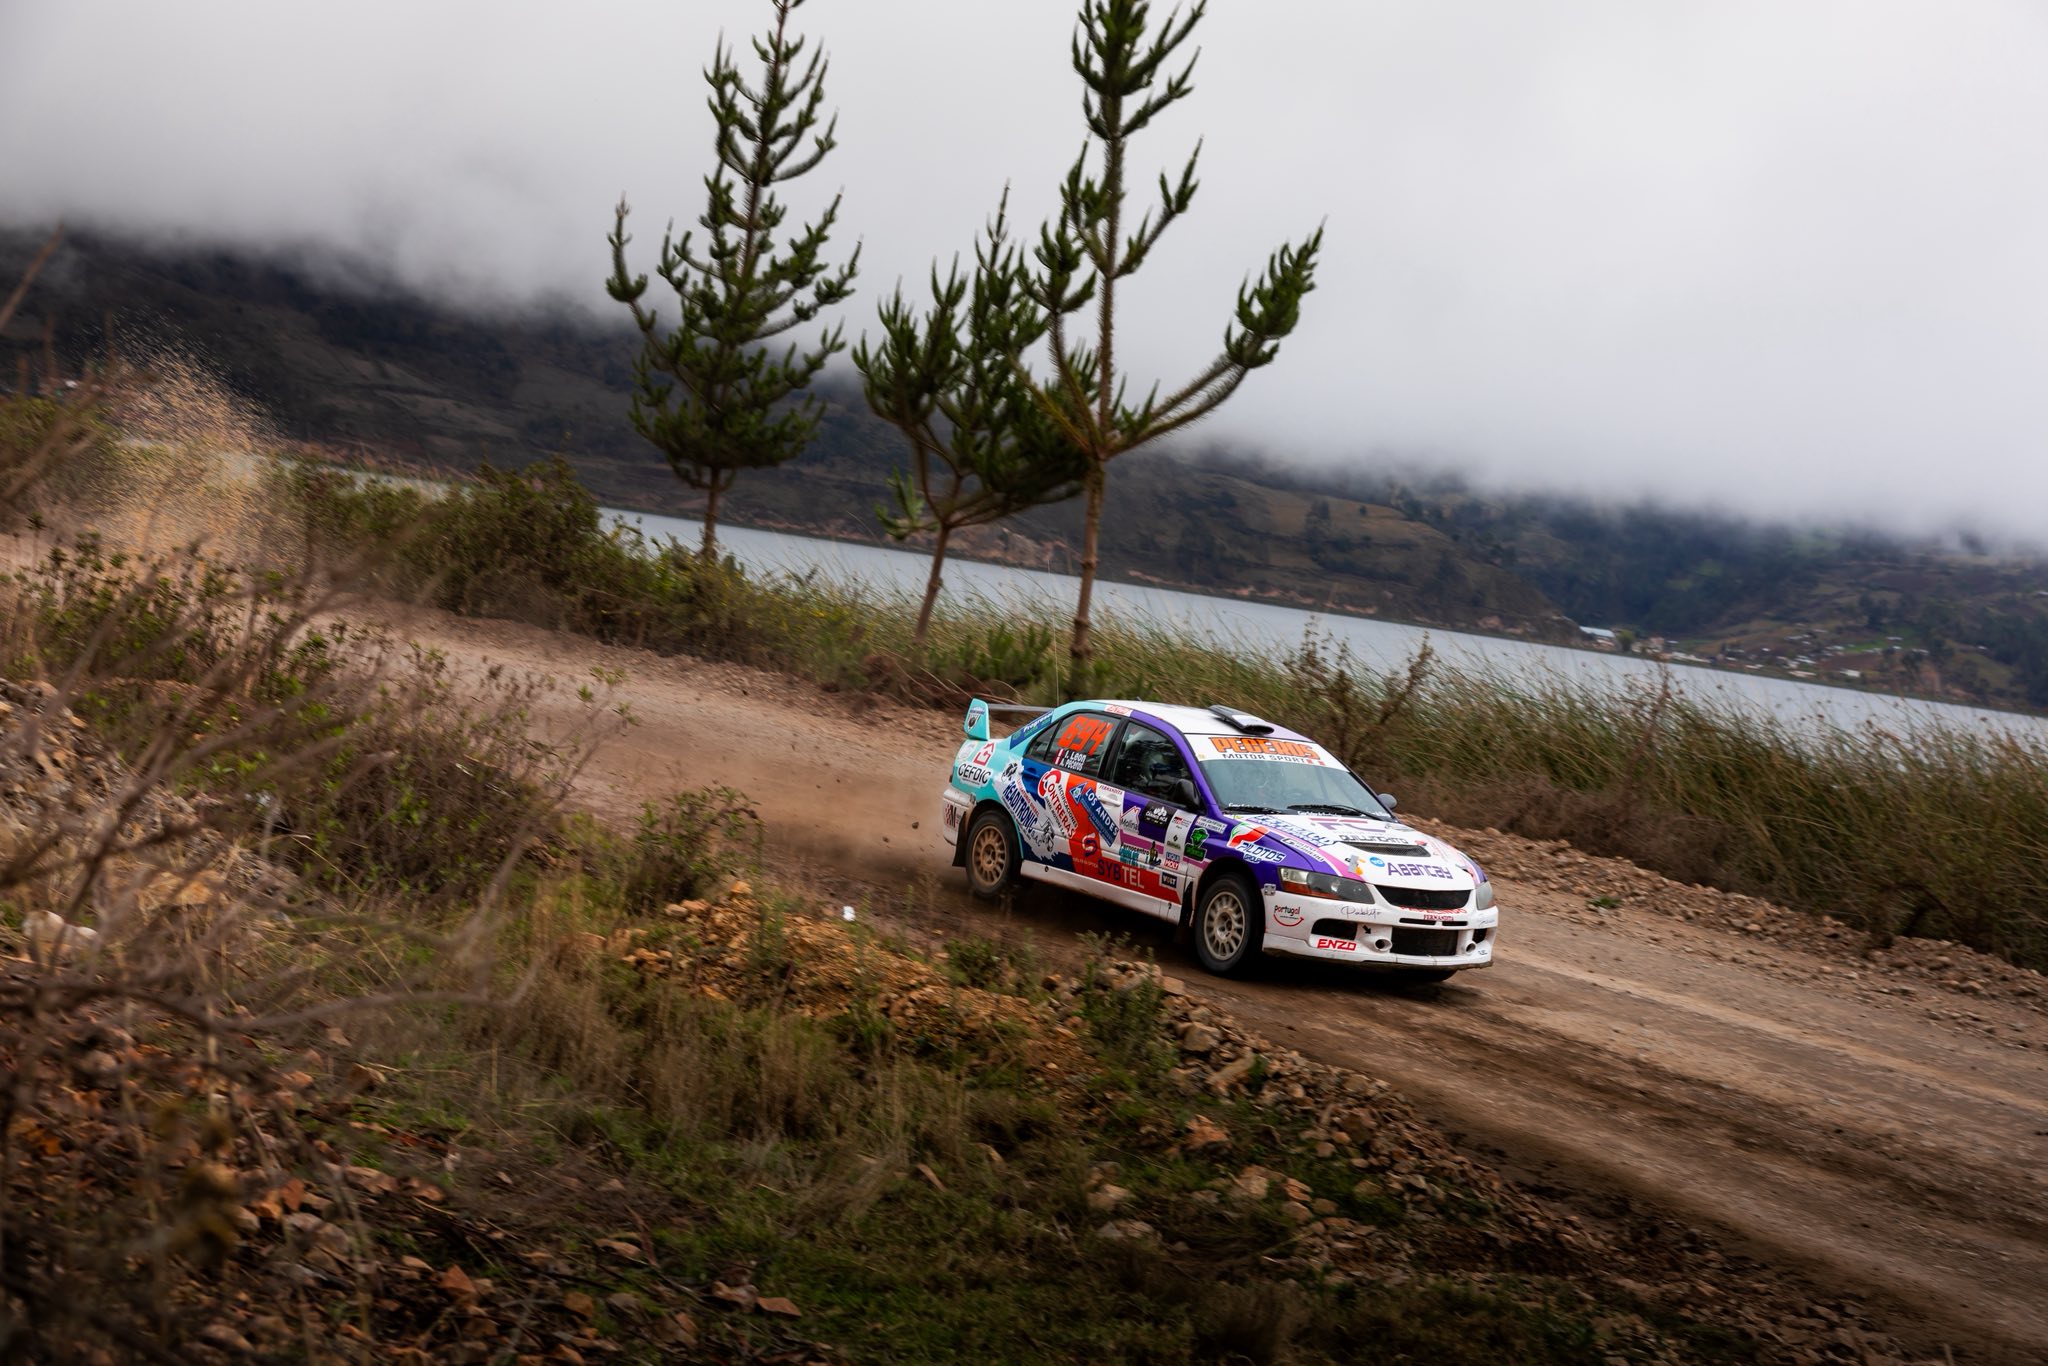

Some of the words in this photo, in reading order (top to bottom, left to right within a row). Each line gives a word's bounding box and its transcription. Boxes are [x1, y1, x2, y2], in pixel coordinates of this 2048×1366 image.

[1057, 715, 1113, 757] 694
[958, 763, 991, 784] CEFDIC
[1269, 755, 1305, 763] SPORT
[1039, 770, 1074, 837] CONTRERAS
[1057, 784, 1078, 827] RECTIFICACIONES
[1085, 788, 1098, 805] LOS
[1095, 806, 1119, 835] ANDES
[1097, 858, 1145, 888] SYBTEL
[1274, 904, 1301, 916] portugal
[1317, 938, 1356, 951] ENZO
